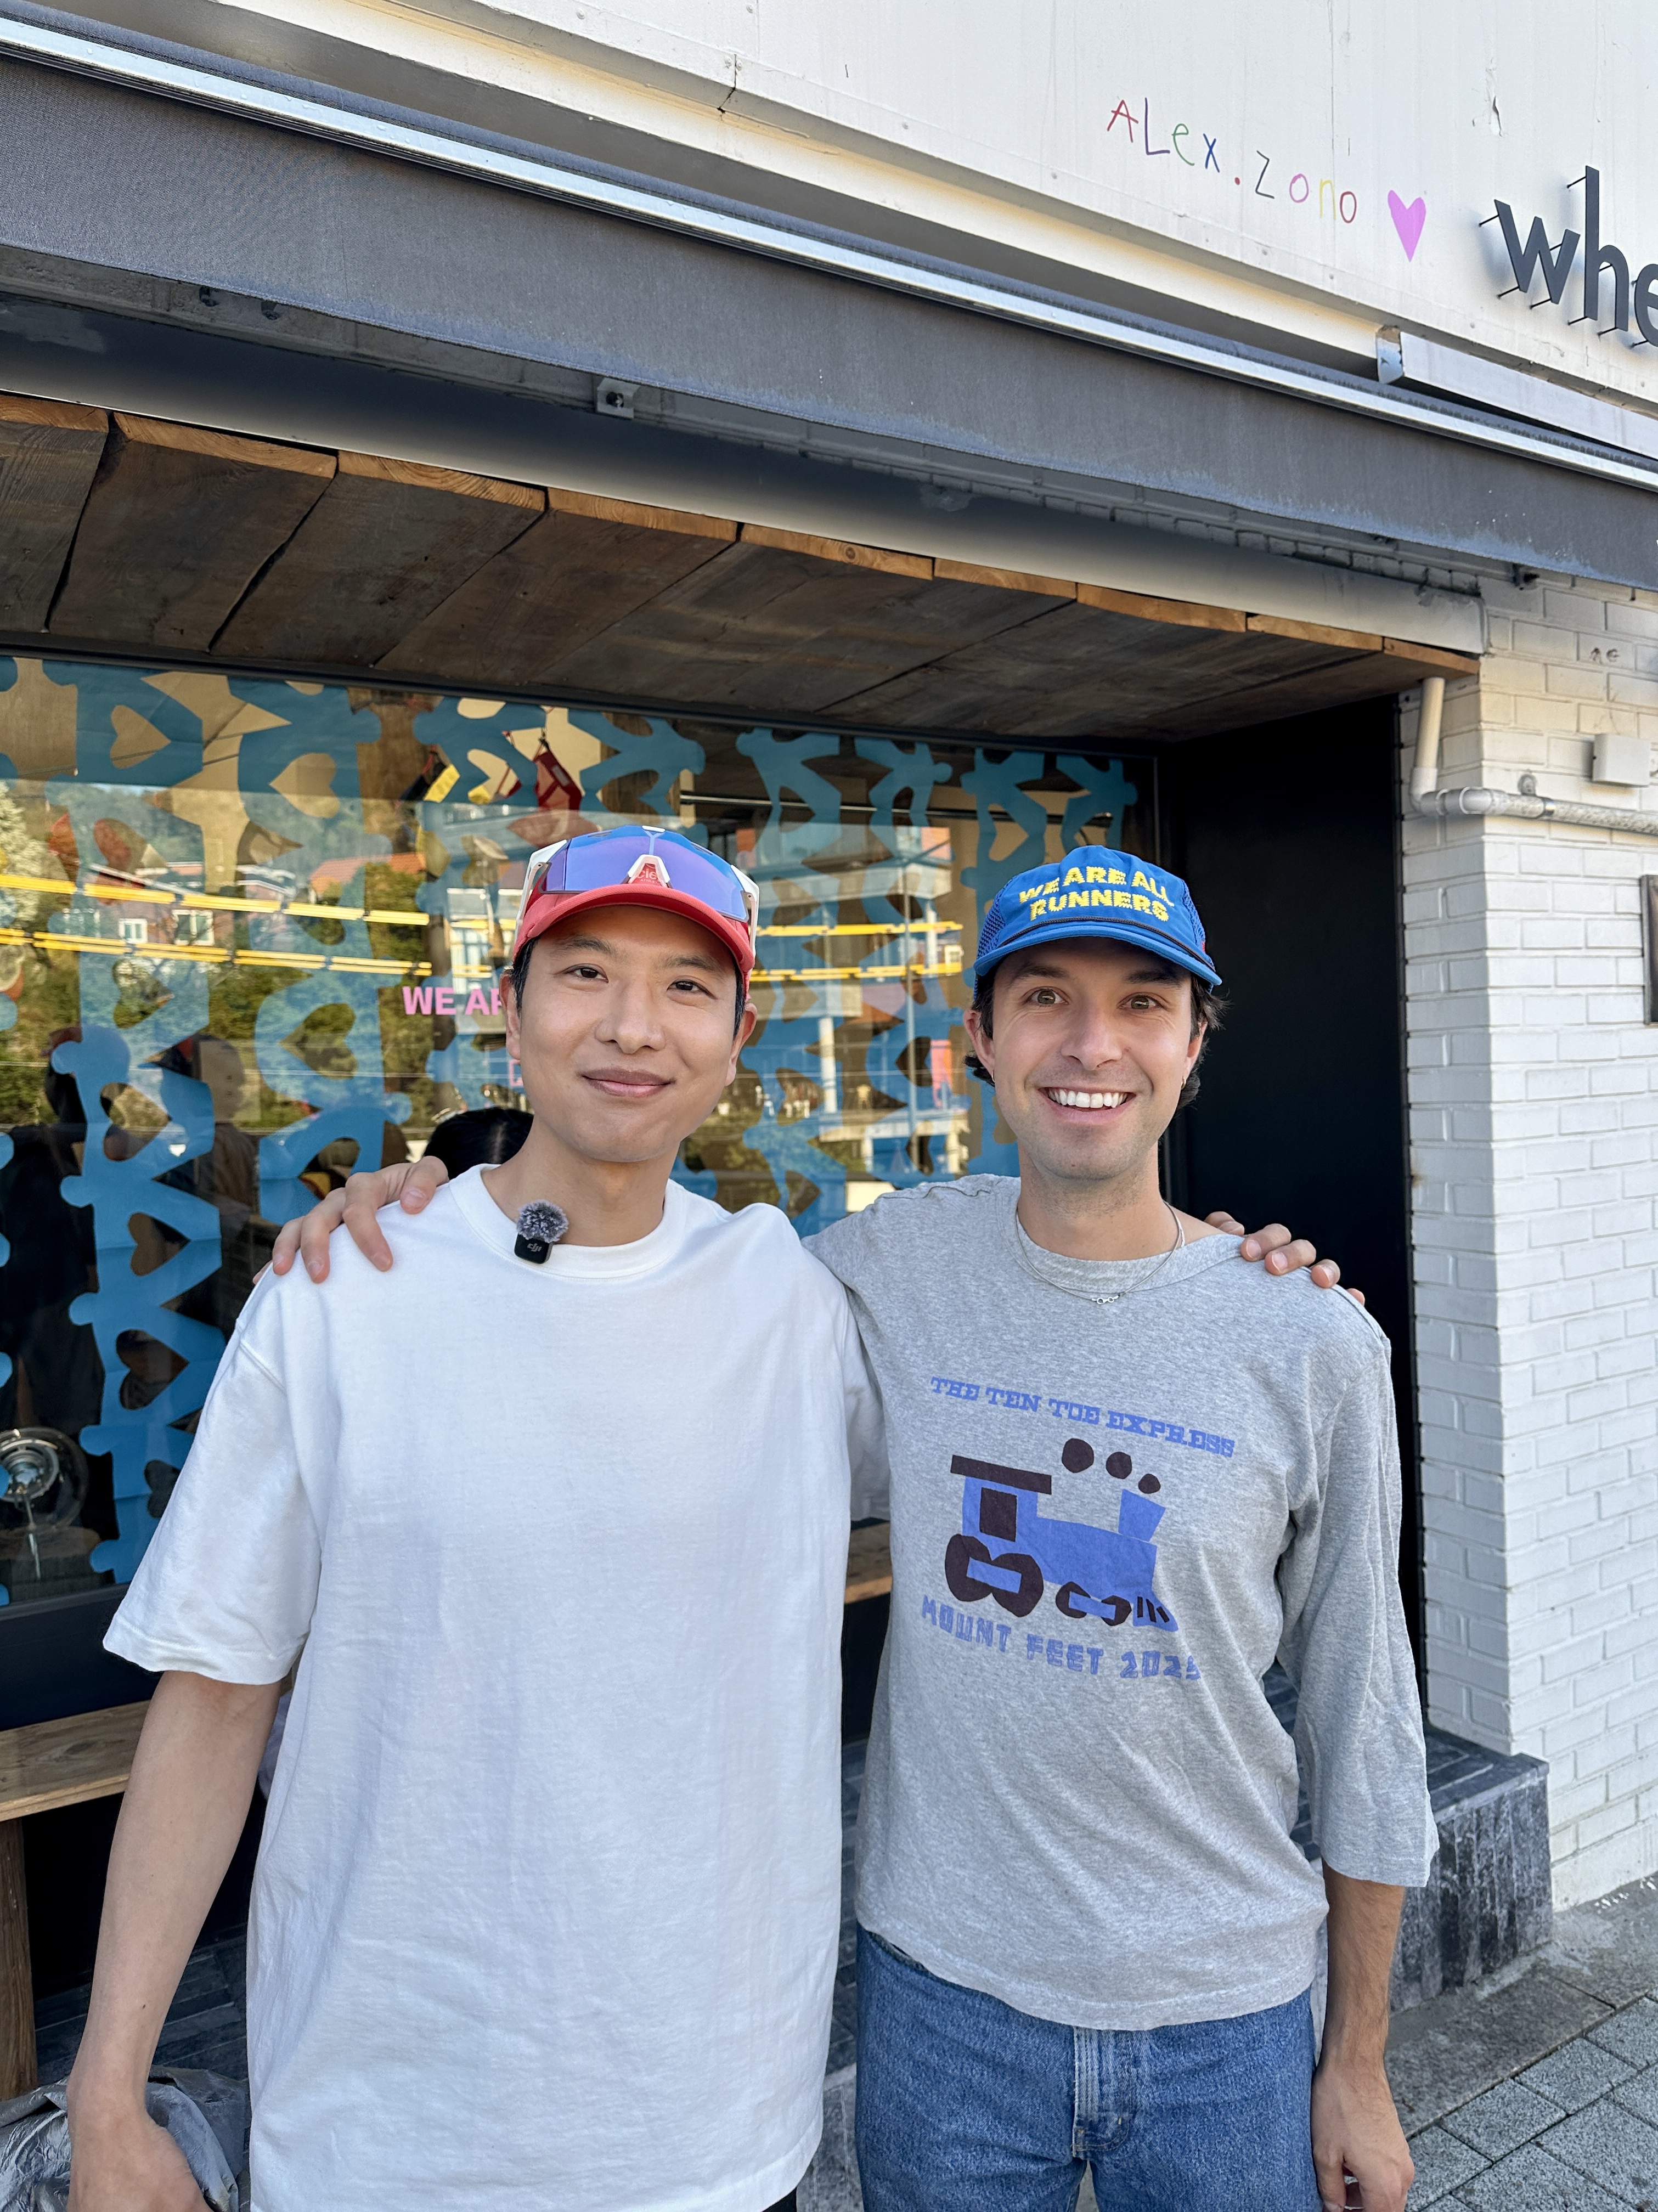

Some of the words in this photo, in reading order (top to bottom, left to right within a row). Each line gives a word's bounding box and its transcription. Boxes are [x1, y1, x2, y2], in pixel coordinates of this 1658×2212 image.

[1493, 165, 1658, 348] whe
[1019, 877, 1059, 904] WE
[1062, 866, 1127, 887] ARE
[1131, 871, 1175, 907] ALL
[1030, 889, 1169, 922] RUNNERS
[402, 986, 456, 1015] WE
[930, 1376, 980, 1401] THE
[985, 1386, 1042, 1413] TEN
[1048, 1398, 1101, 1425] TOE
[1105, 1410, 1235, 1458] EXPRESS
[921, 1595, 1012, 1652] MOUNT
[1026, 1633, 1104, 1675] FEET
